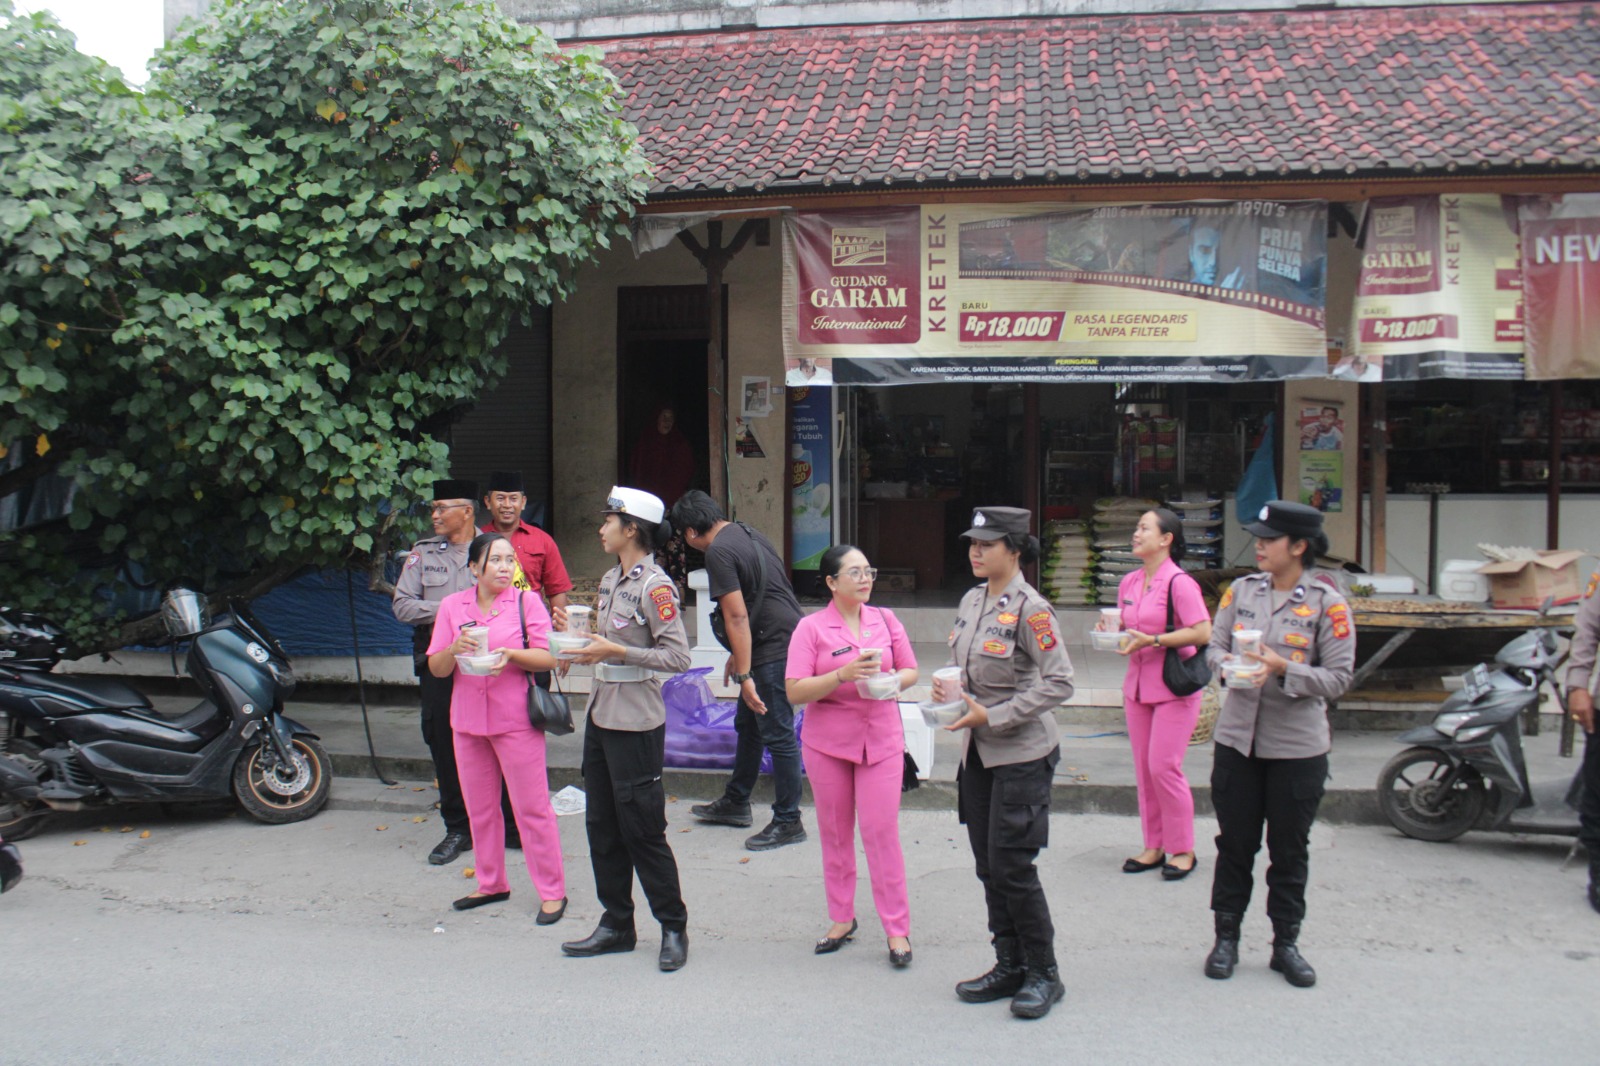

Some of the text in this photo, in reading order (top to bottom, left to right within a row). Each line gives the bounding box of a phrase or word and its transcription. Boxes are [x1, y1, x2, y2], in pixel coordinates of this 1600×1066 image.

[1260, 227, 1302, 250] PRIA
[1446, 197, 1460, 286] KRETEK
[1259, 245, 1302, 267] PUNYA
[1362, 251, 1432, 269] GARAM
[928, 213, 946, 333] KRETEK
[1257, 258, 1301, 282] SELERA
[830, 275, 887, 288] GUDANG
[1364, 271, 1433, 286] International
[810, 287, 907, 309] GARAM
[961, 302, 989, 310] BARU
[810, 314, 906, 331] International
[1074, 313, 1188, 325] RASA LEGENDARIS
[1087, 326, 1170, 337] TANPA FILTER
[798, 432, 823, 440] Tubuh
[424, 564, 448, 574] WINATA
[985, 626, 1017, 639] POLRI
